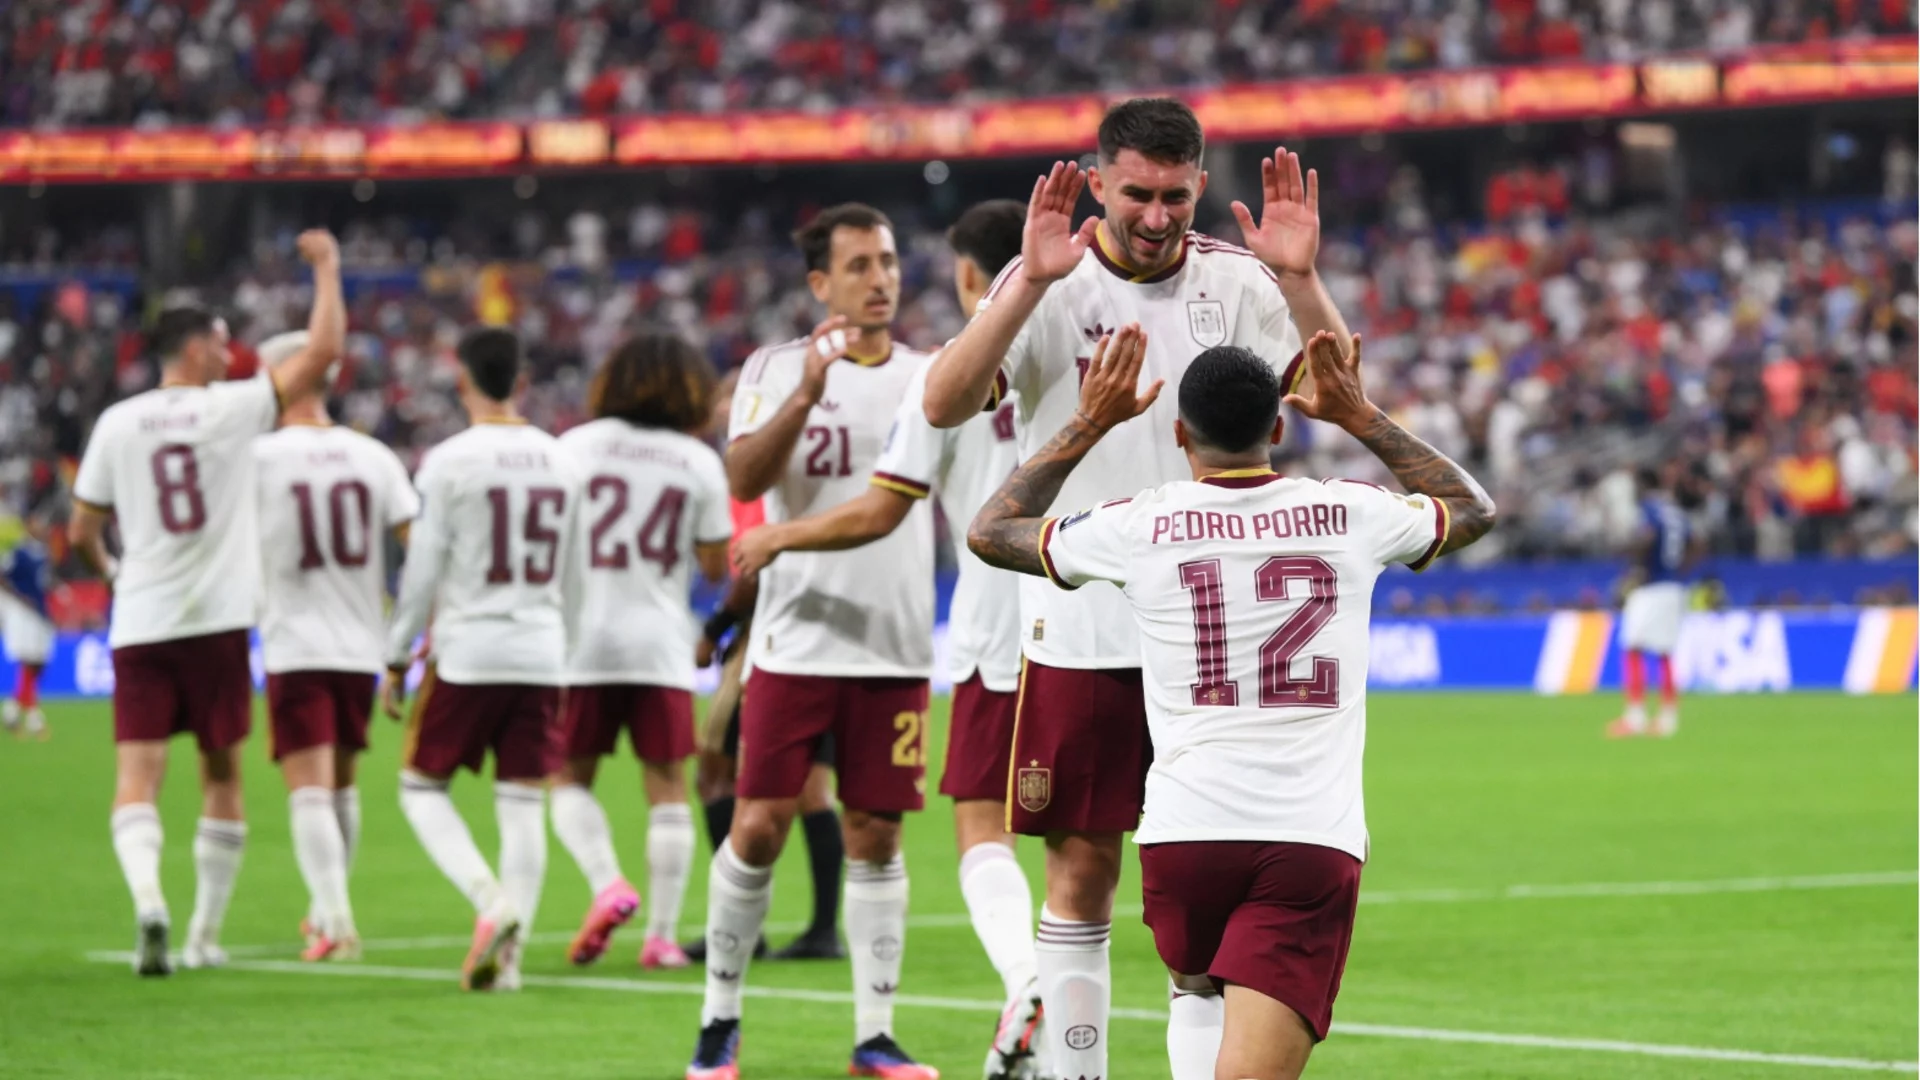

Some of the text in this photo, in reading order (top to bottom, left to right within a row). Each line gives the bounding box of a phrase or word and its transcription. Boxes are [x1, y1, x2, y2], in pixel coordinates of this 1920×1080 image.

[151, 443, 206, 534] 8
[806, 425, 851, 478] 21
[291, 480, 370, 569] 10
[486, 486, 565, 584] 15
[588, 474, 688, 576] 24
[1152, 503, 1347, 544] PEDRO PORRO
[1178, 555, 1339, 708] 12
